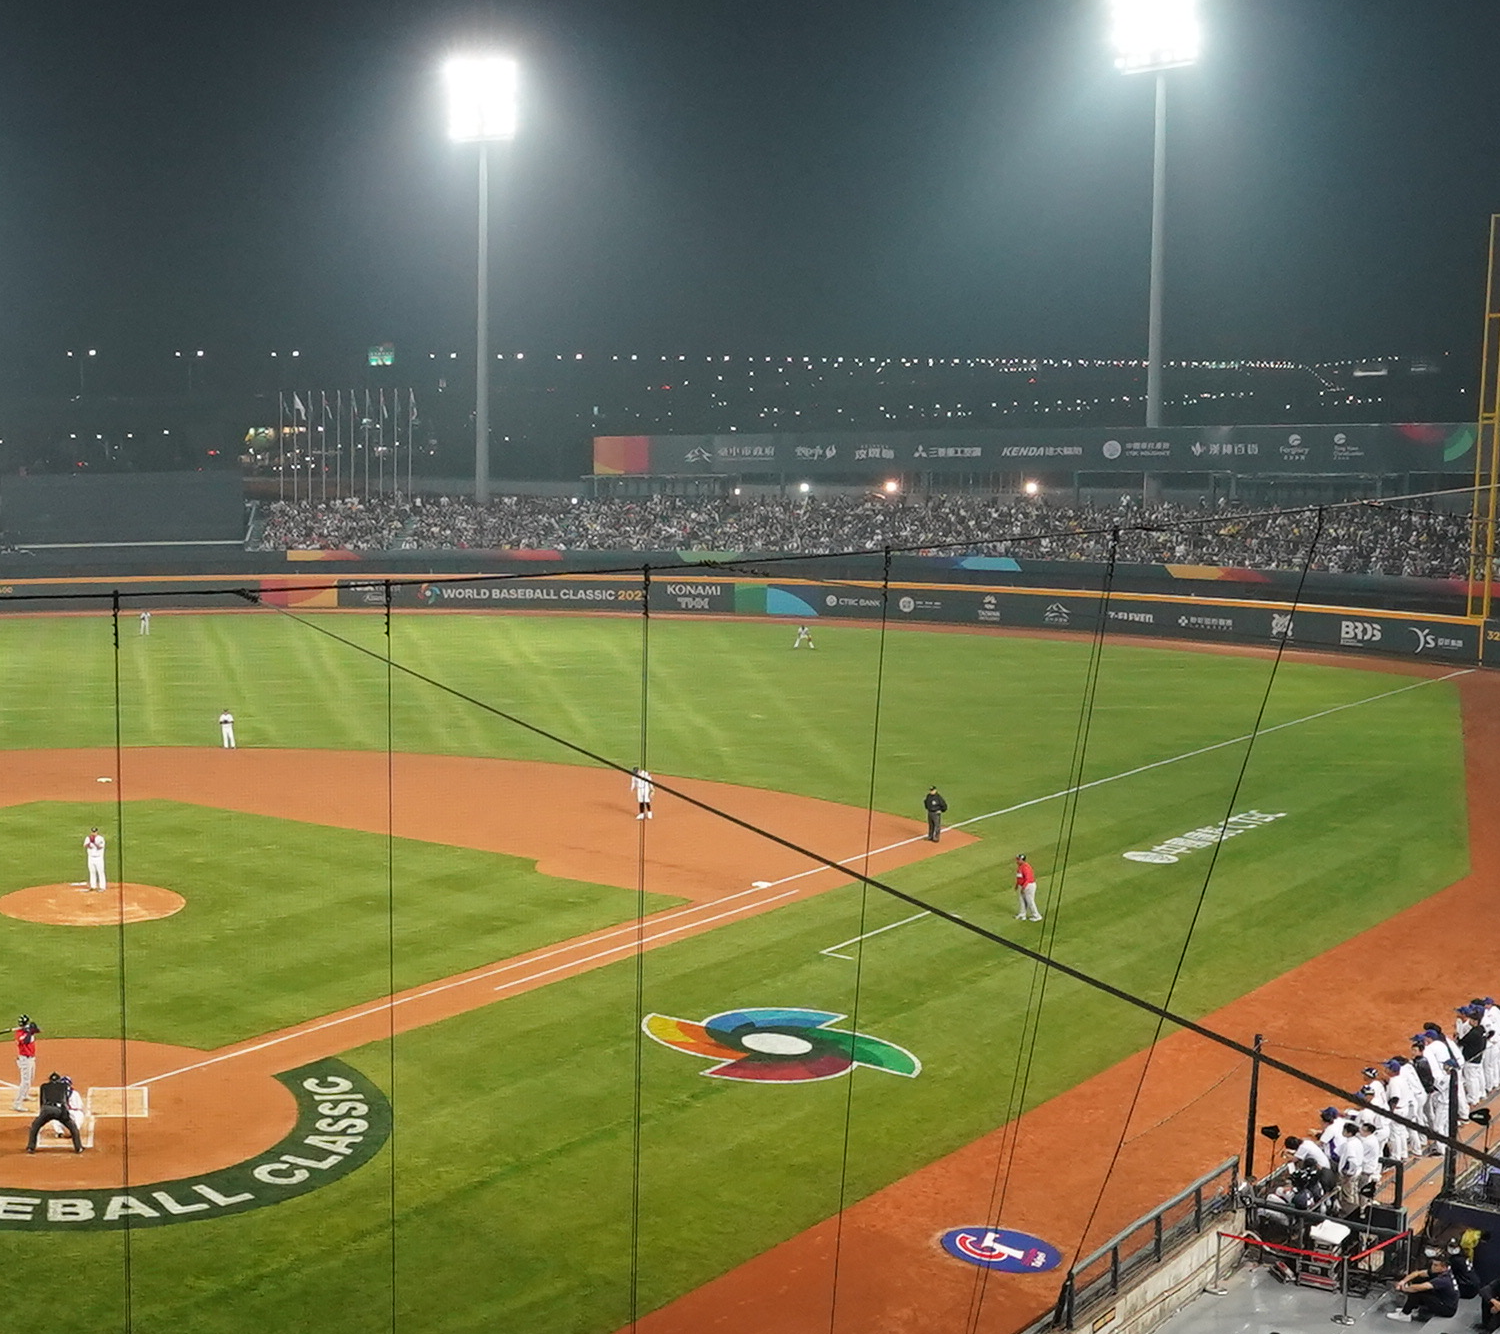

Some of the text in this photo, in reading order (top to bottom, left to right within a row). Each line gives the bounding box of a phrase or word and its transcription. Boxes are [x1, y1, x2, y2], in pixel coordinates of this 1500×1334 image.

[1001, 447, 1045, 457] KENDA
[442, 587, 645, 601] WORLD BASEBALL CLASSIC 202
[666, 584, 722, 596] KONAMI
[251, 1074, 370, 1186] CLASSIC
